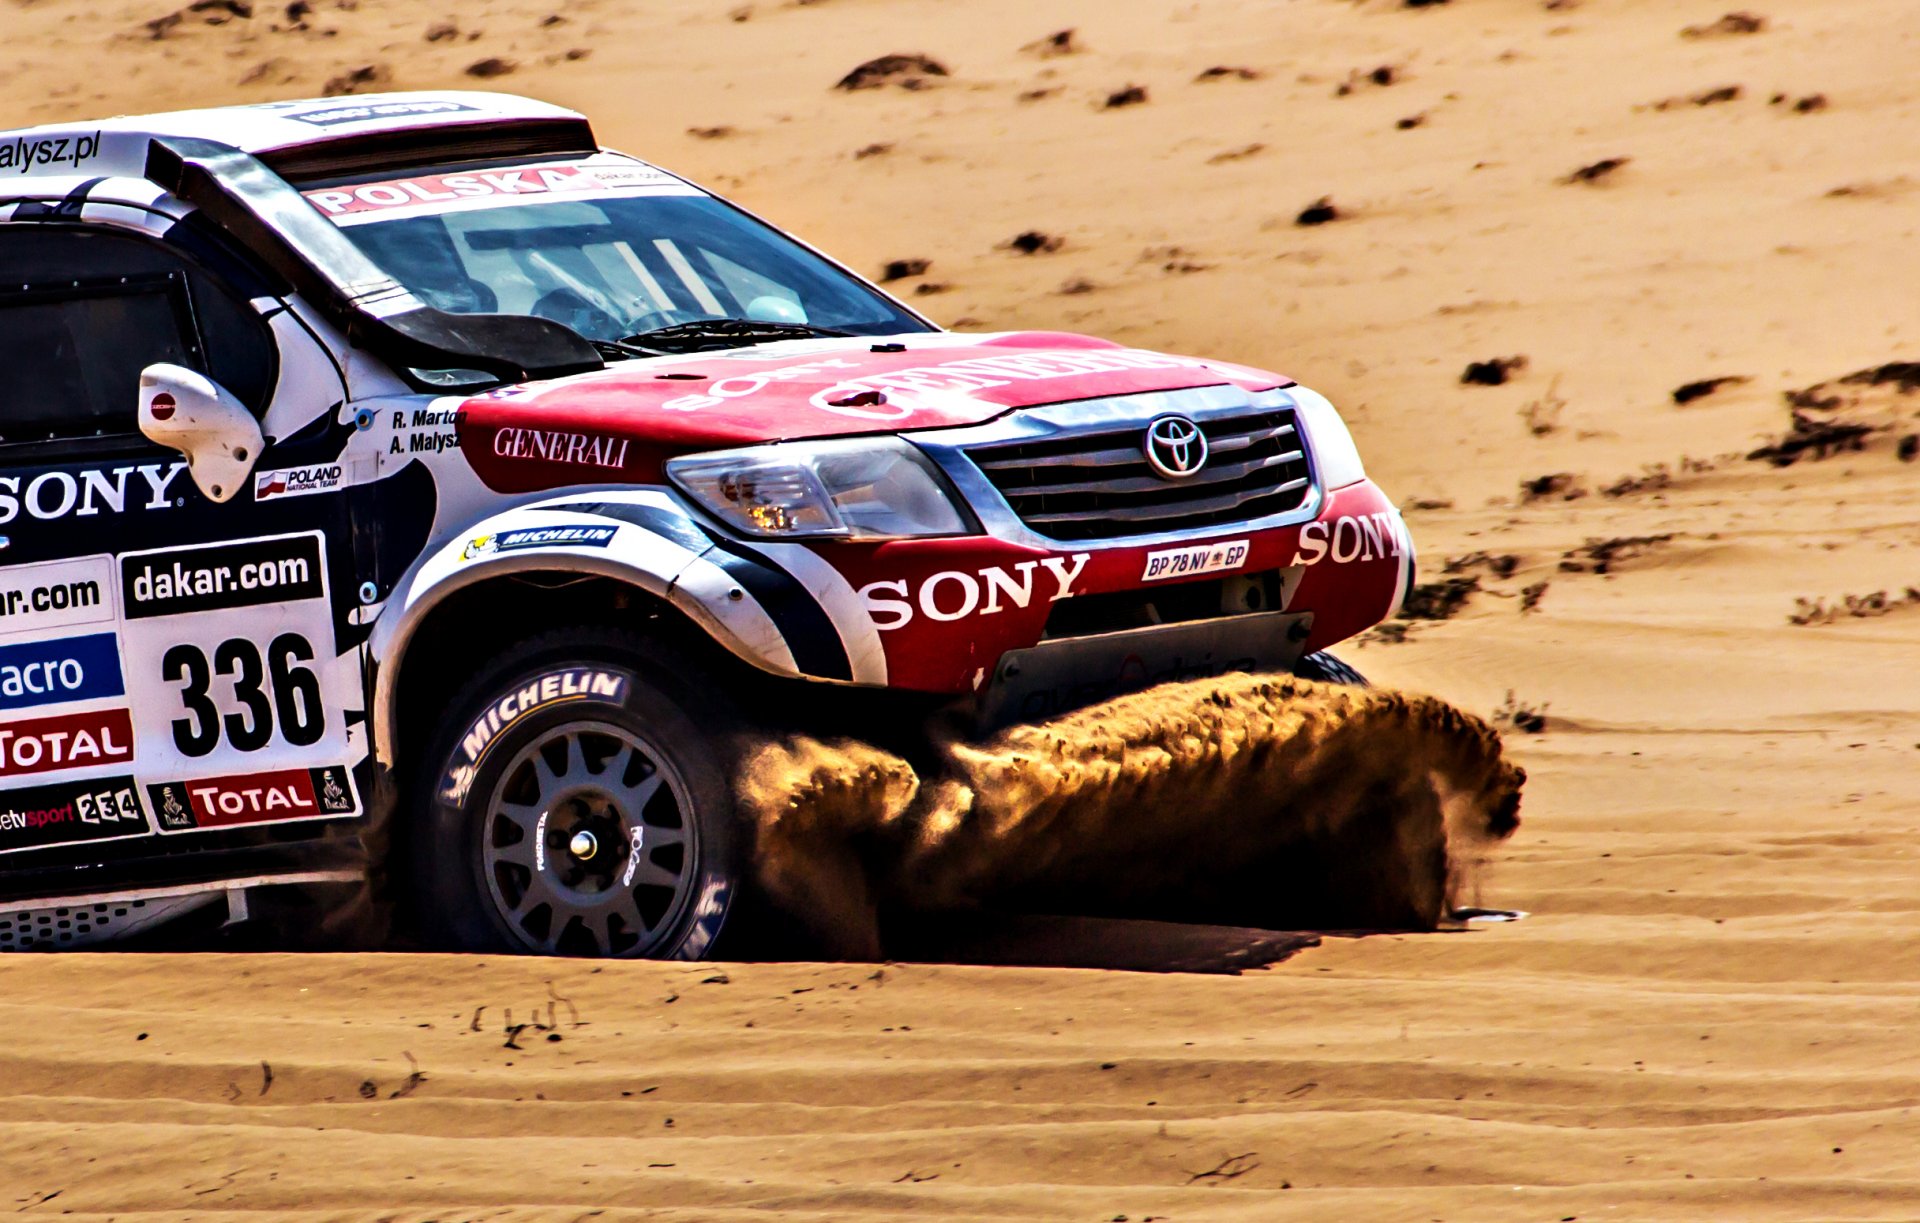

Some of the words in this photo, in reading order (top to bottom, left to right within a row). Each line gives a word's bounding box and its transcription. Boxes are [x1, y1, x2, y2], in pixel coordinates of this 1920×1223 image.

[0, 129, 101, 173] alysz.pl
[305, 169, 569, 216] POLSKA
[392, 411, 406, 430] R.
[389, 435, 405, 454] A.
[409, 431, 463, 454] Malysz
[494, 427, 631, 469] GENERALI
[0, 461, 189, 525] SONY
[286, 482, 317, 491] NATIONAL
[319, 479, 338, 488] TEAM
[288, 465, 342, 485] POLAND
[502, 527, 617, 545] MICHELIN
[133, 556, 309, 602] dakar.com
[1147, 556, 1170, 577] BP
[1170, 553, 1189, 574] 78
[1224, 546, 1245, 566] GP
[860, 553, 1091, 632] SONY
[161, 632, 326, 758] 336
[462, 671, 625, 762] MICHELIN
[80, 793, 138, 821] 234
[192, 785, 314, 817] TOTAL
